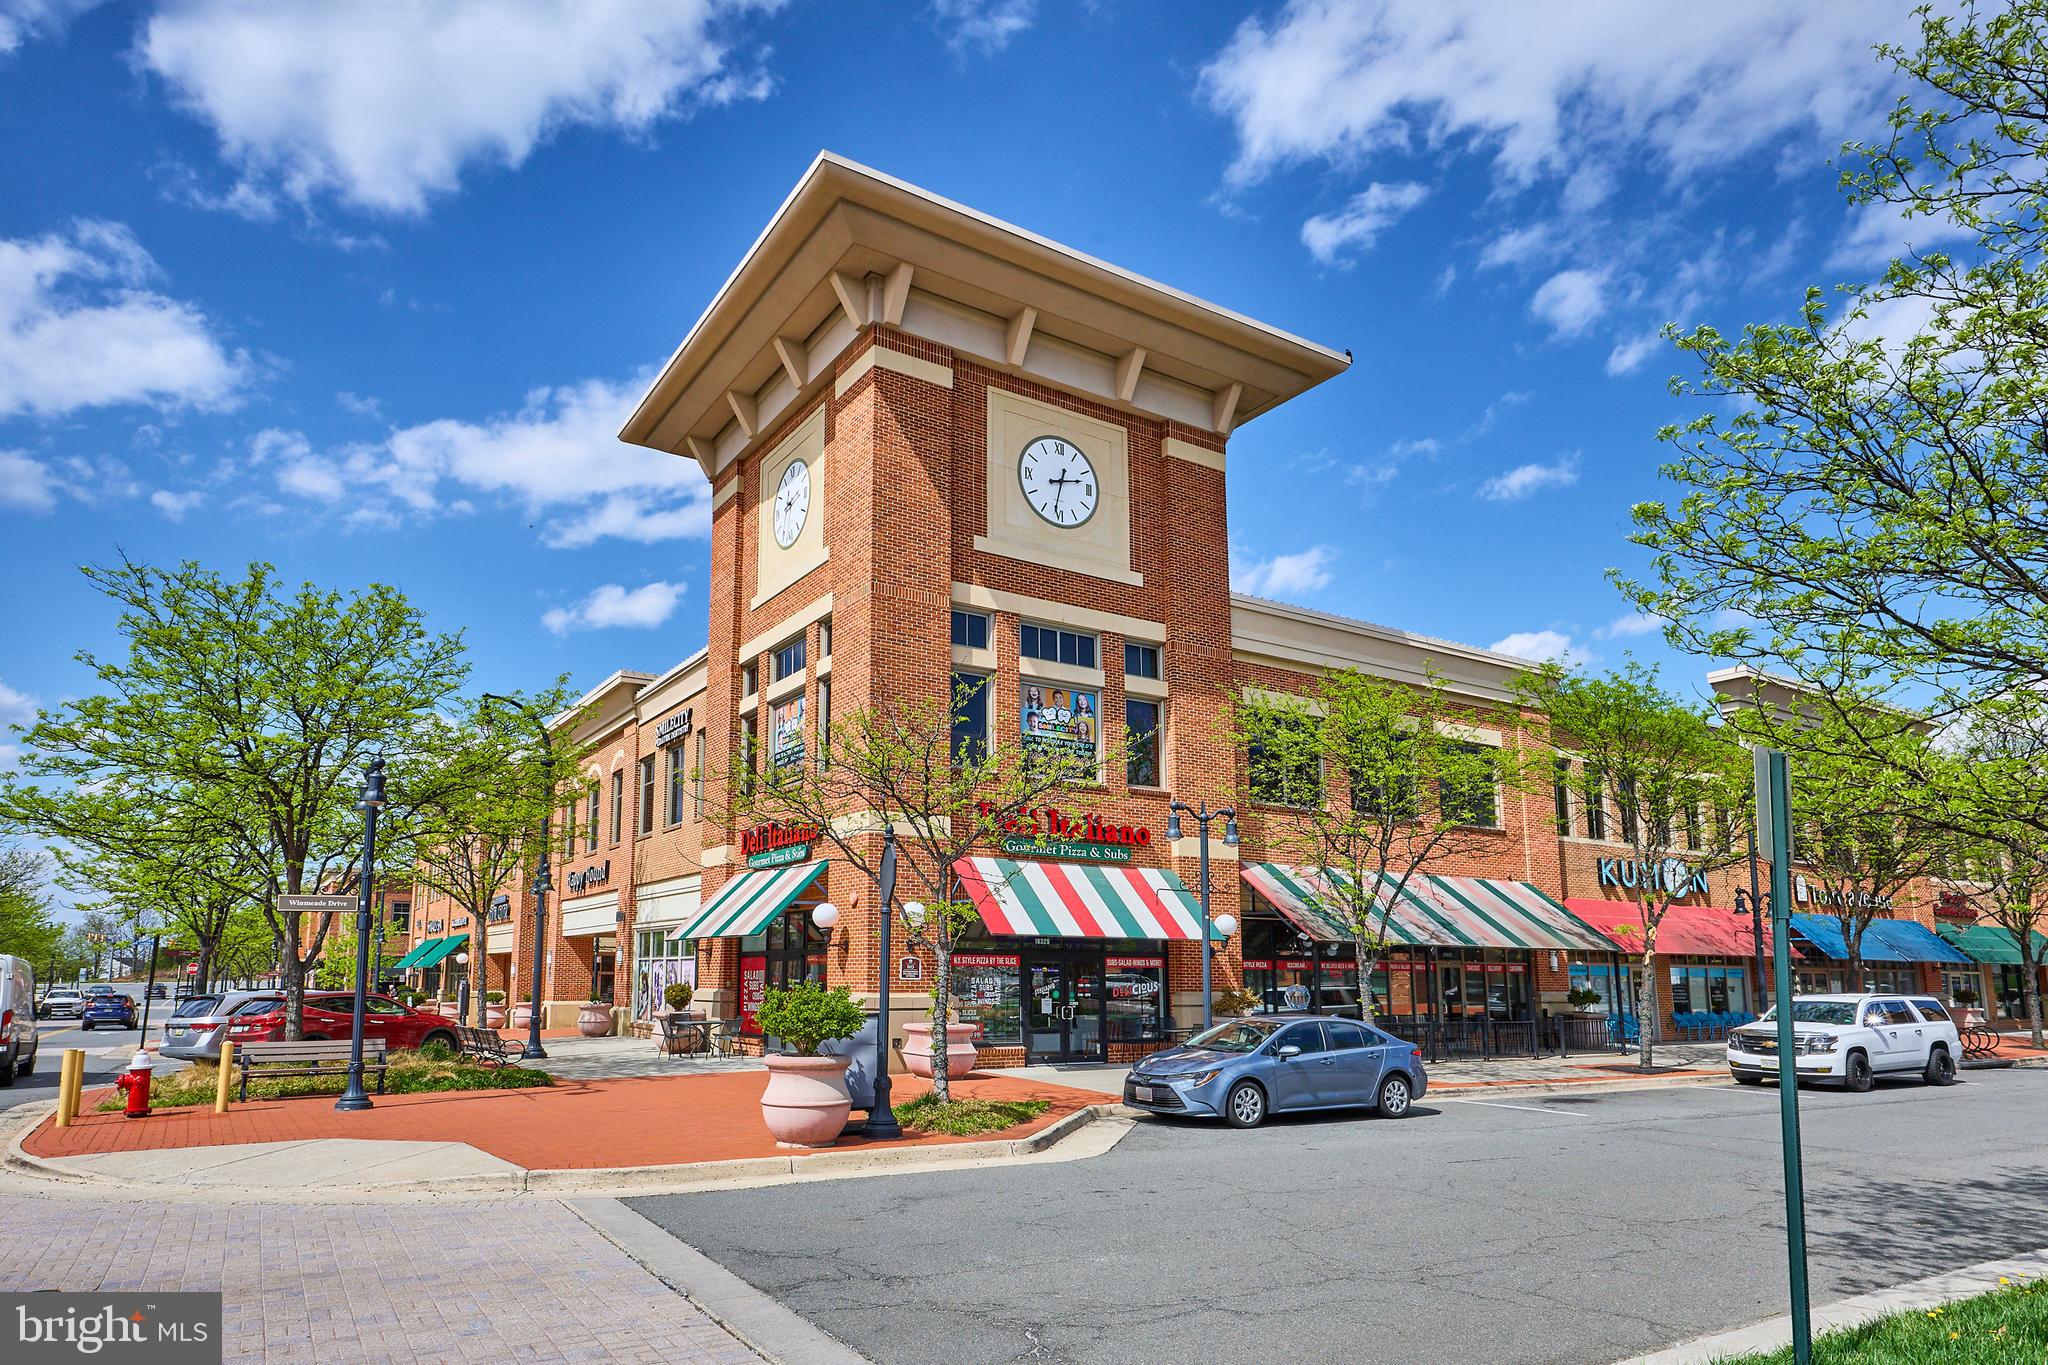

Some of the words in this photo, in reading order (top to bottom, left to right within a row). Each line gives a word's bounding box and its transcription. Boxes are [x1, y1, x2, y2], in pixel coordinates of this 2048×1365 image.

[1045, 809, 1151, 845] Italiano
[741, 825, 765, 855] Deli
[771, 852, 785, 863] Pizza
[785, 850, 791, 861] &
[1060, 844, 1087, 857] Pizza
[1090, 846, 1101, 858] &
[1104, 847, 1128, 860] Subs
[289, 899, 326, 907] Winmeade
[976, 957, 990, 965] PIZZA
